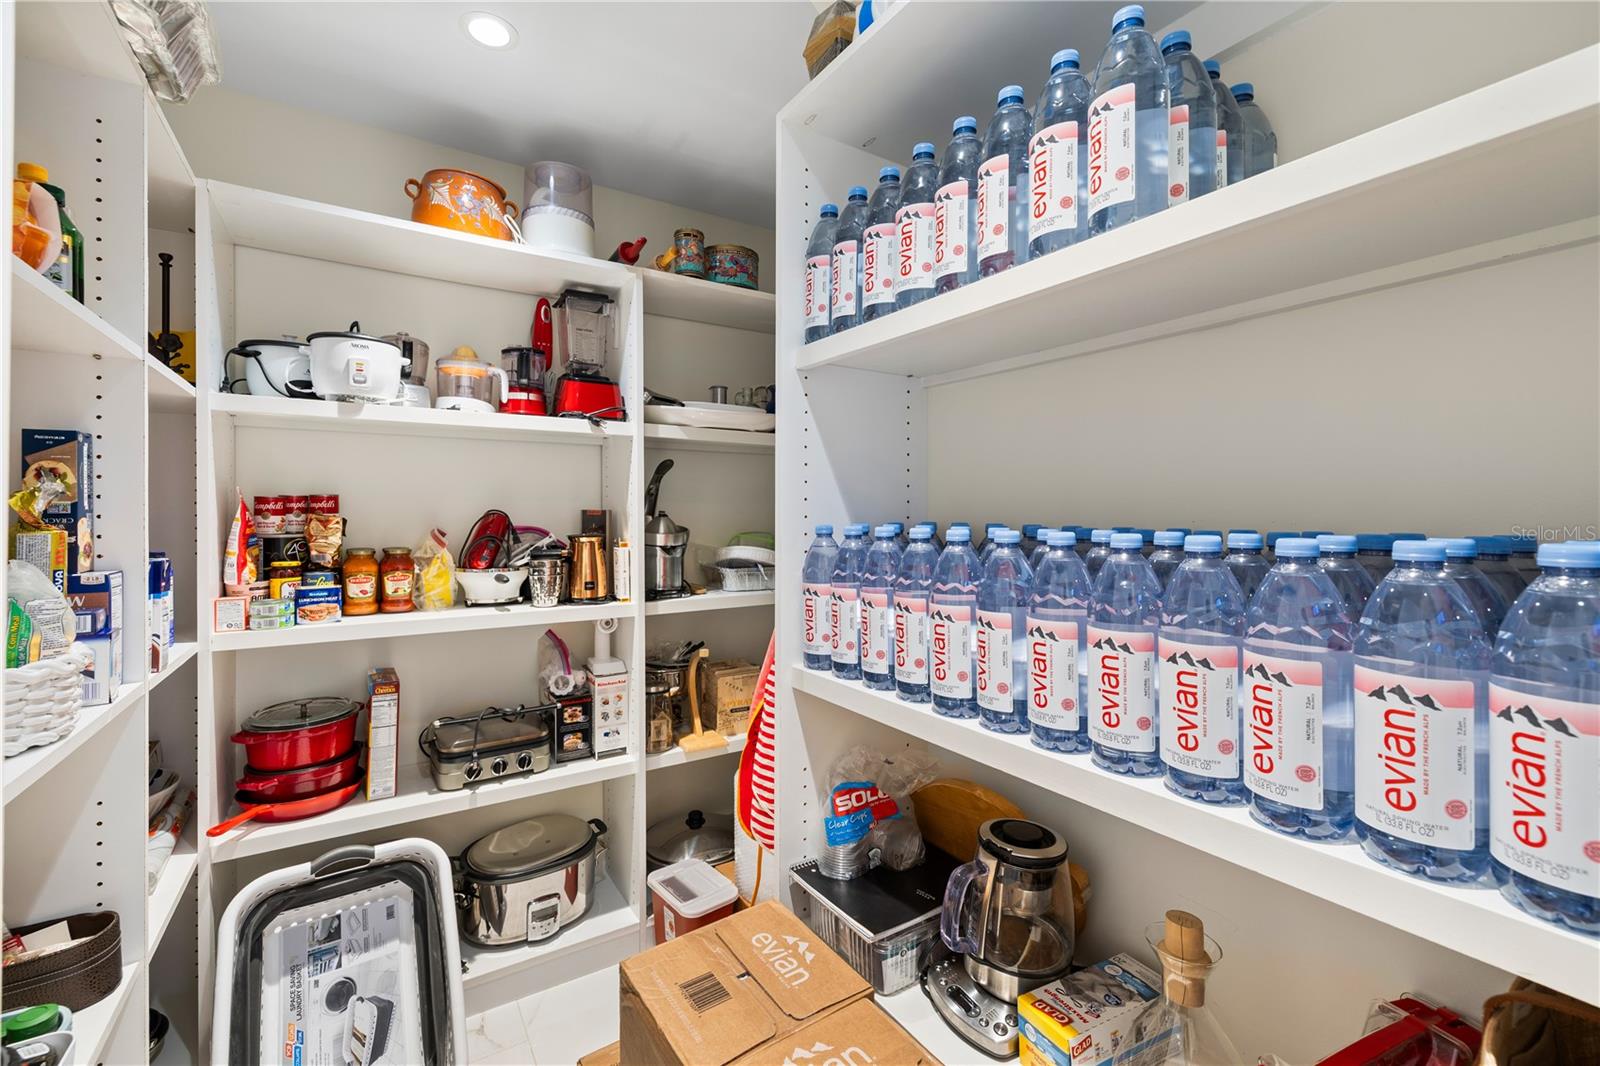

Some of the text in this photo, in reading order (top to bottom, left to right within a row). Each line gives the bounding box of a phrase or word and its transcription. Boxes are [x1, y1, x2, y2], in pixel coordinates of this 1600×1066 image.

[1089, 119, 1102, 195] evian
[1032, 149, 1047, 219] evian
[935, 205, 944, 263] evian
[977, 183, 985, 245] evian
[864, 241, 875, 293] evian
[899, 220, 913, 277] evian
[804, 270, 812, 317] evian
[832, 258, 840, 306] evian
[805, 598, 815, 642] evian
[831, 603, 840, 649] evian
[861, 609, 869, 658] evian
[896, 614, 905, 667] evian
[933, 623, 947, 681] evian
[976, 631, 987, 691] evian
[1031, 641, 1048, 709] evian
[1098, 654, 1120, 729] evian
[1173, 669, 1199, 752] evian
[1250, 683, 1274, 775] evian
[1278, 736, 1282, 744] BY
[1378, 707, 1417, 812] evian
[1423, 768, 1430, 776] BY
[1506, 731, 1547, 849] evian
[1556, 802, 1562, 811] BY
[828, 811, 868, 830] Clear Cups
[1406, 822, 1416, 834] FL
[1418, 824, 1435, 838] OZ)
[1423, 821, 1449, 832] WATER
[751, 932, 811, 988] evian
[1034, 1001, 1070, 1024] GLAD
[1074, 1038, 1092, 1056] GLAD
